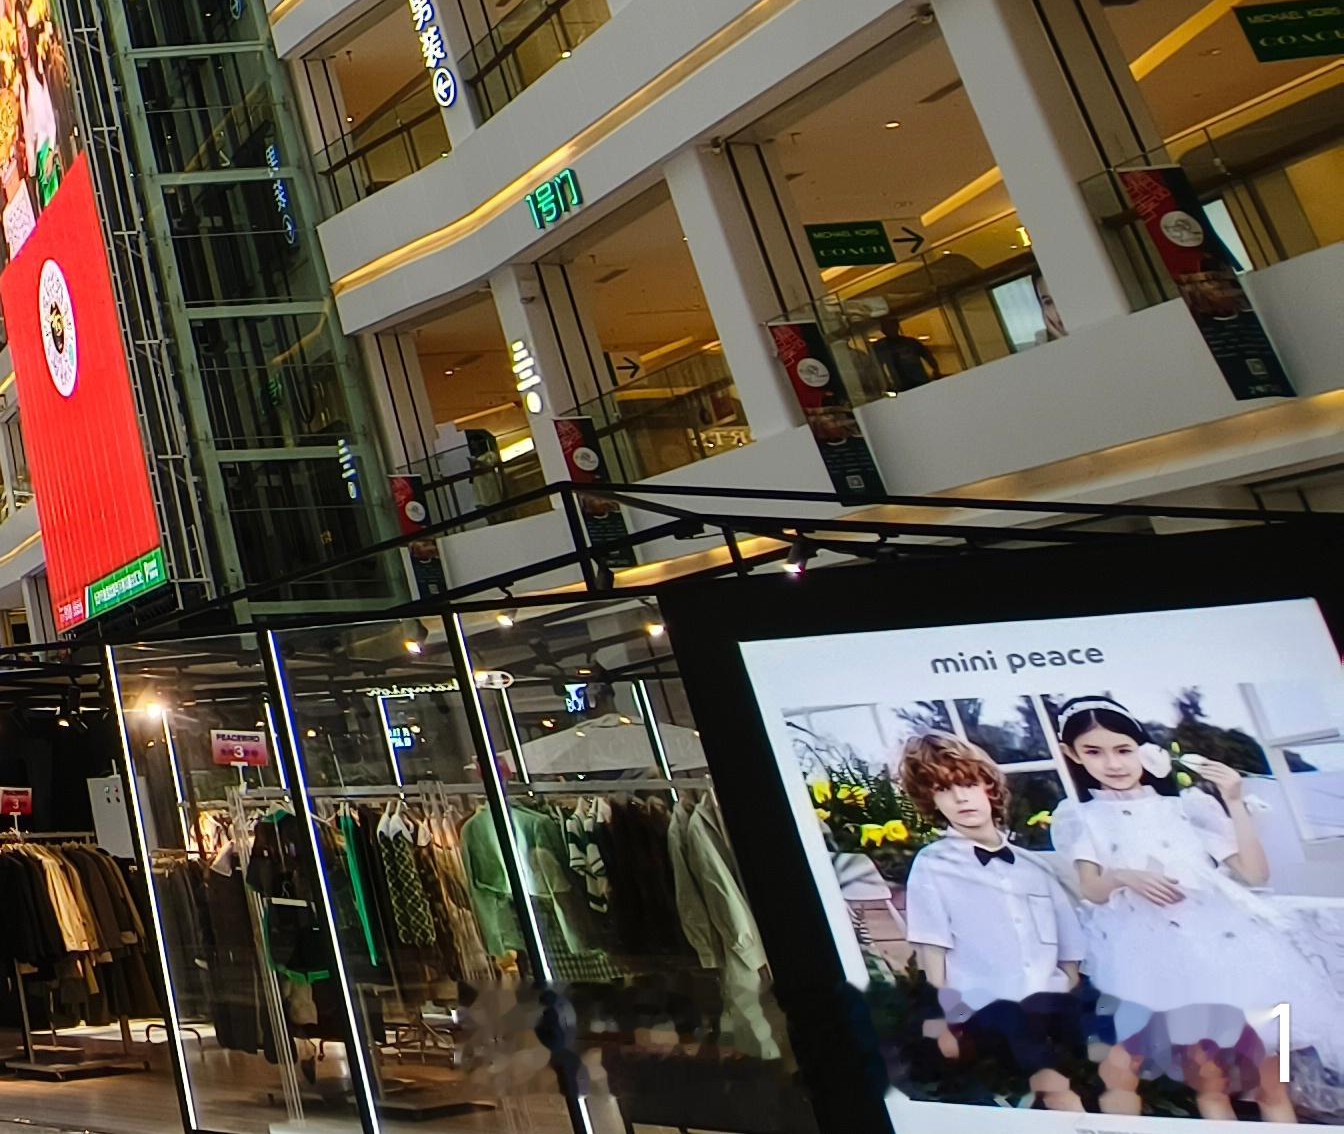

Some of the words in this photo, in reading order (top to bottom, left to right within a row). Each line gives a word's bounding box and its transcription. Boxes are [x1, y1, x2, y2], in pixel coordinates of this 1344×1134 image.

[525, 168, 580, 229] 1号门
[930, 649, 998, 674] mini
[1006, 647, 1105, 674] peace
[216, 733, 260, 743] PEACEBIRD
[233, 745, 244, 758] 3
